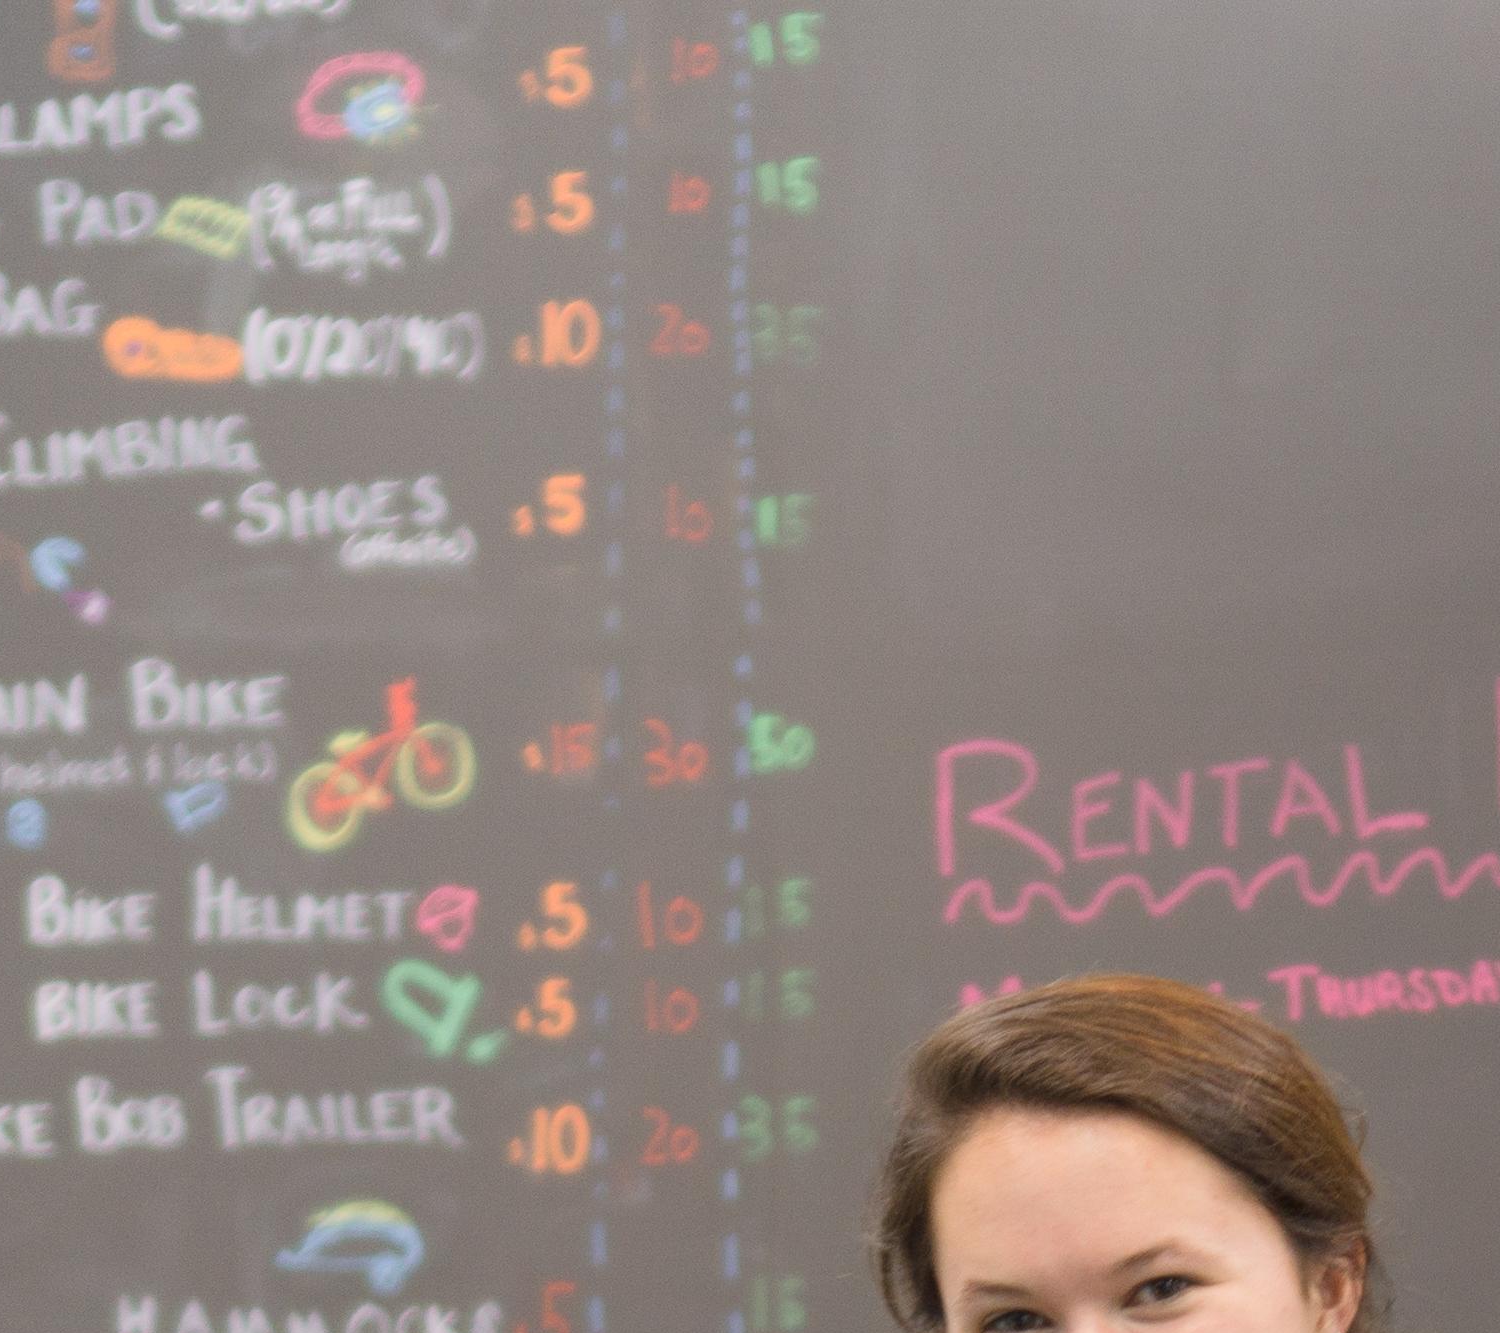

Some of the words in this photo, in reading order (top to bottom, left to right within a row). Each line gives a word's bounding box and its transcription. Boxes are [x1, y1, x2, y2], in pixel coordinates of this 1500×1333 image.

[748, 10, 827, 67] 15
[39, 179, 159, 243] PAD
[754, 154, 824, 217] 15
[130, 657, 289, 731] BIKE
[937, 736, 1429, 876] RENTAL
[26, 874, 159, 946] BIKE
[194, 862, 412, 944] HELMET
[637, 880, 703, 951] 10
[33, 980, 161, 1040] BIKE
[194, 969, 370, 1035] LOCK
[644, 978, 701, 1035] 10
[76, 1077, 185, 1151] BOB
[205, 1065, 464, 1149] TRAILER
[640, 1105, 701, 1167] 20
